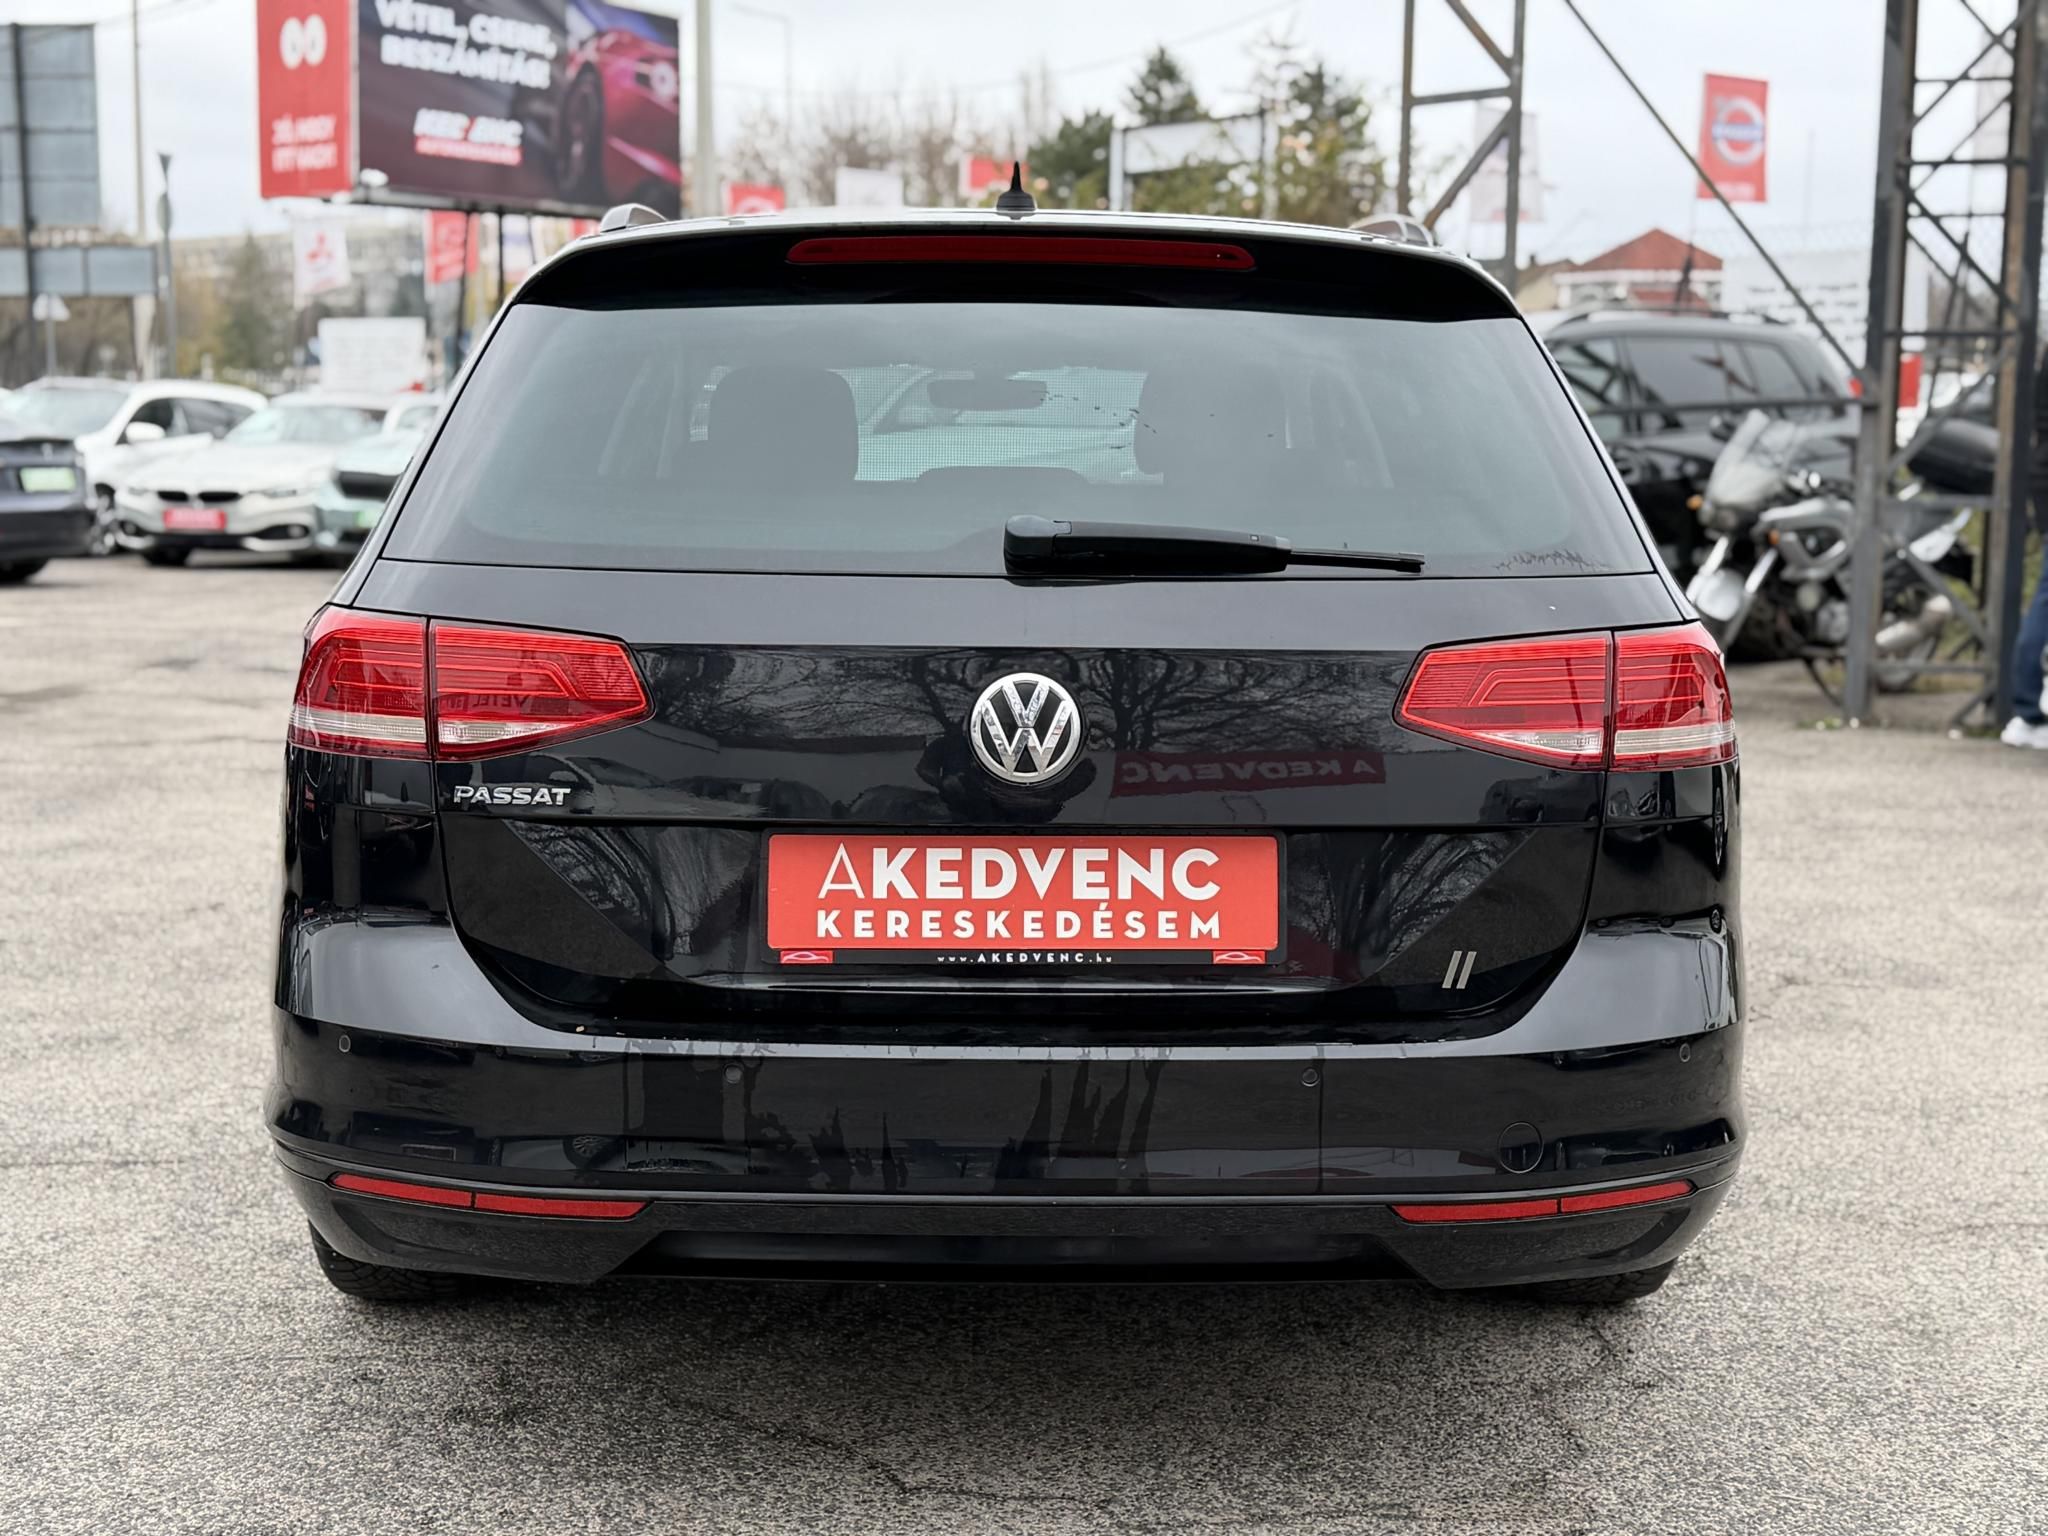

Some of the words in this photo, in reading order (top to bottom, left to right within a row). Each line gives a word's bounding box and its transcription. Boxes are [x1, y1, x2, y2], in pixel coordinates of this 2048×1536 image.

[453, 785, 572, 806] PASSAT
[817, 842, 1221, 901] AKEDVENC
[816, 903, 1221, 939] KERESKEDÉSEM
[937, 952, 1112, 963] www.AKEDVENC.hu
